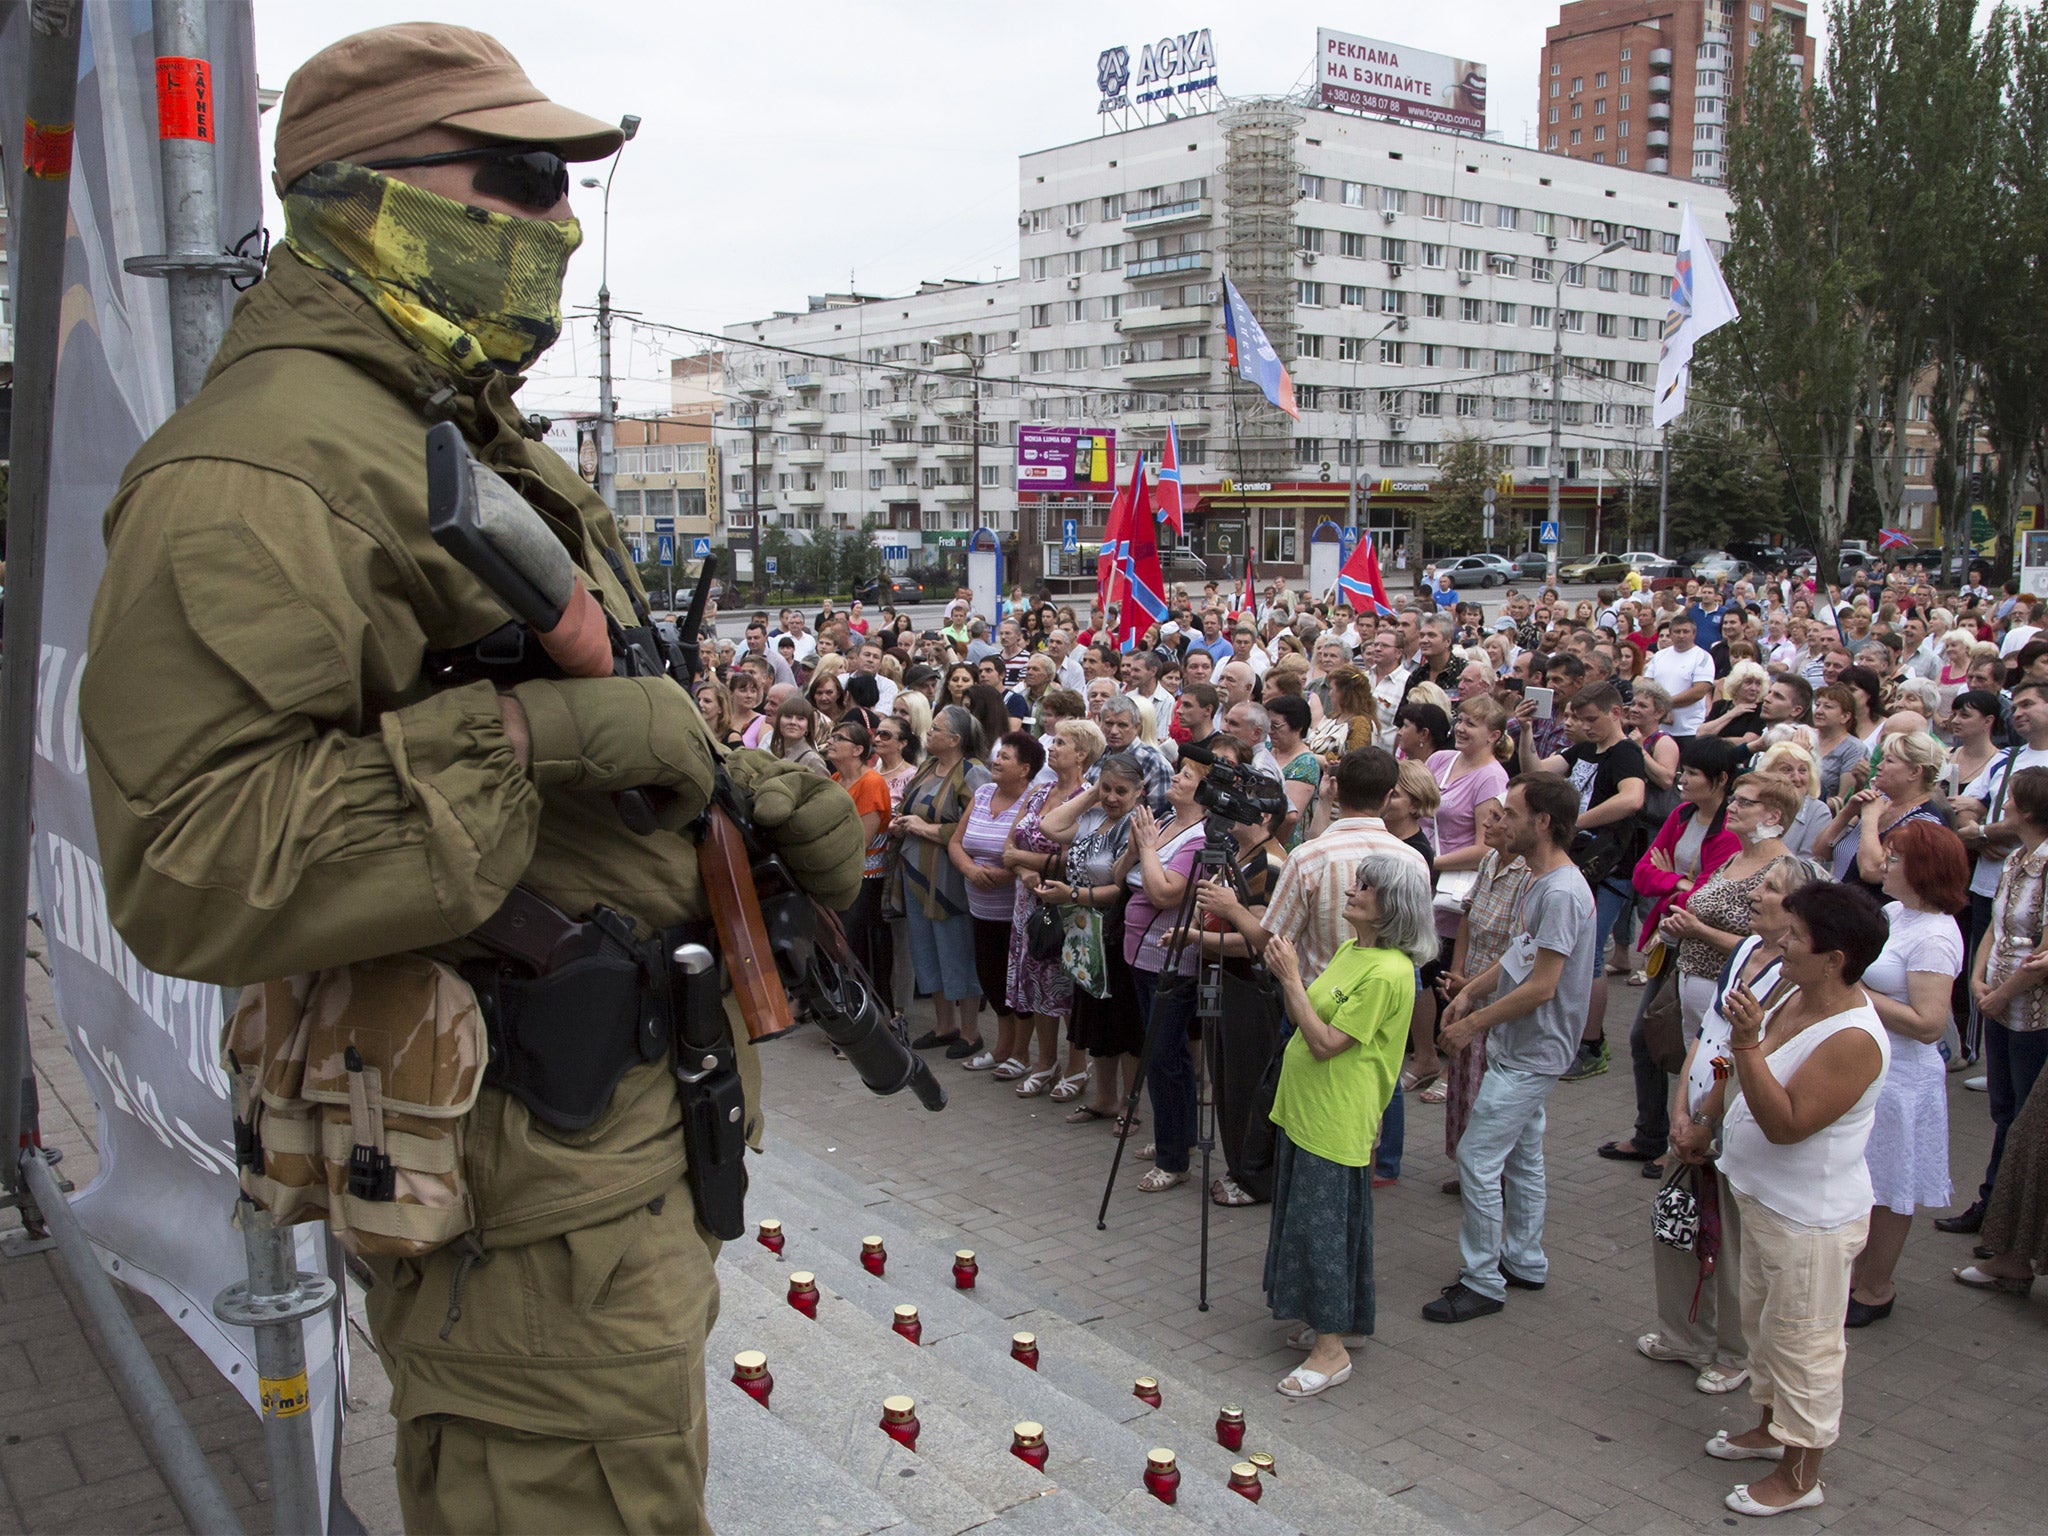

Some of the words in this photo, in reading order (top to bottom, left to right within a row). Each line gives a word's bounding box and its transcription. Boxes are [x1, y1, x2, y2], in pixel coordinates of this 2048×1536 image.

[1137, 28, 1215, 86] АСКА
[1328, 39, 1399, 68] РЕКЛАМА
[1328, 62, 1348, 79] НА
[1354, 67, 1432, 96] БЭКЛАЙТЕ
[1328, 89, 1349, 102] +380
[1351, 93, 1360, 104] 62
[1362, 94, 1377, 108] 348
[1378, 98, 1388, 109] 07
[1390, 101, 1400, 112] 88
[707, 447, 717, 521] НОТАРИУС
